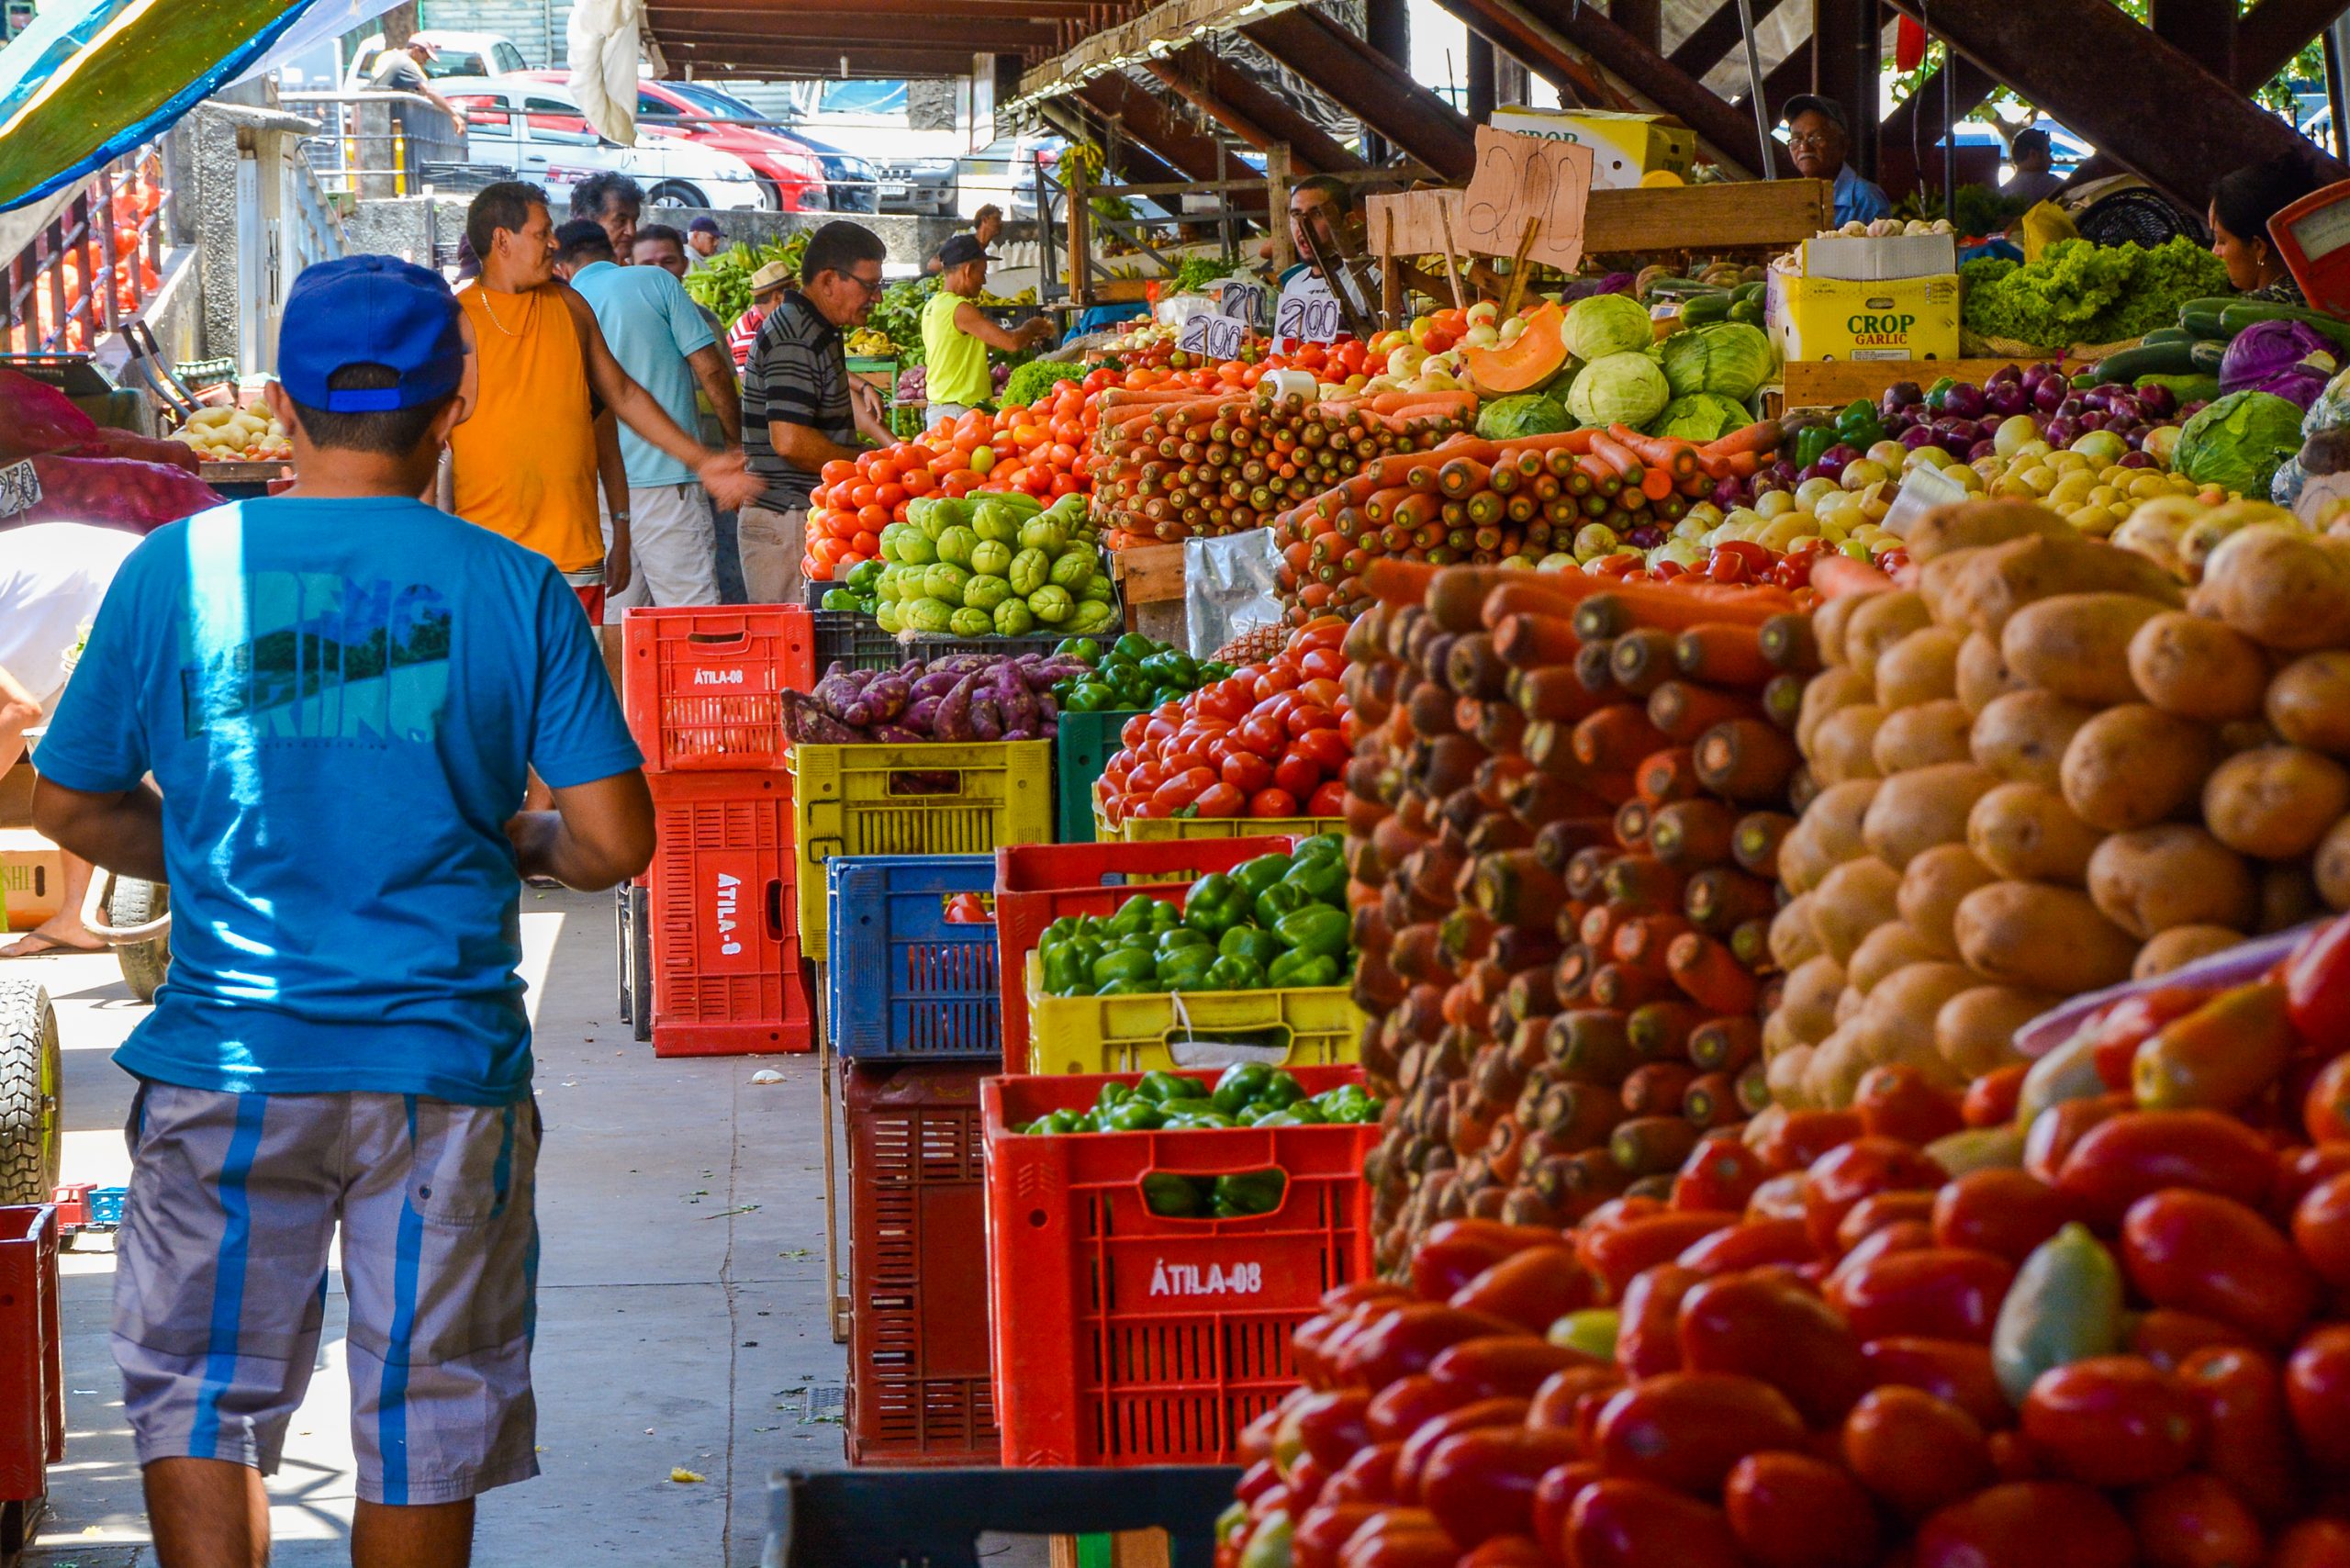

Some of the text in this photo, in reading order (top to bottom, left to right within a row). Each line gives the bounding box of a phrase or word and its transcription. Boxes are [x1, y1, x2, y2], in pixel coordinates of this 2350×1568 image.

[1469, 145, 1579, 252] 200
[1182, 315, 1241, 360] 200
[1278, 298, 1337, 341] 200
[1847, 314, 1916, 334] CROP
[1855, 333, 1908, 345] GARLIC
[694, 666, 743, 685] ÁTILA-08
[1149, 1257, 1262, 1296] ÁTILA-08
